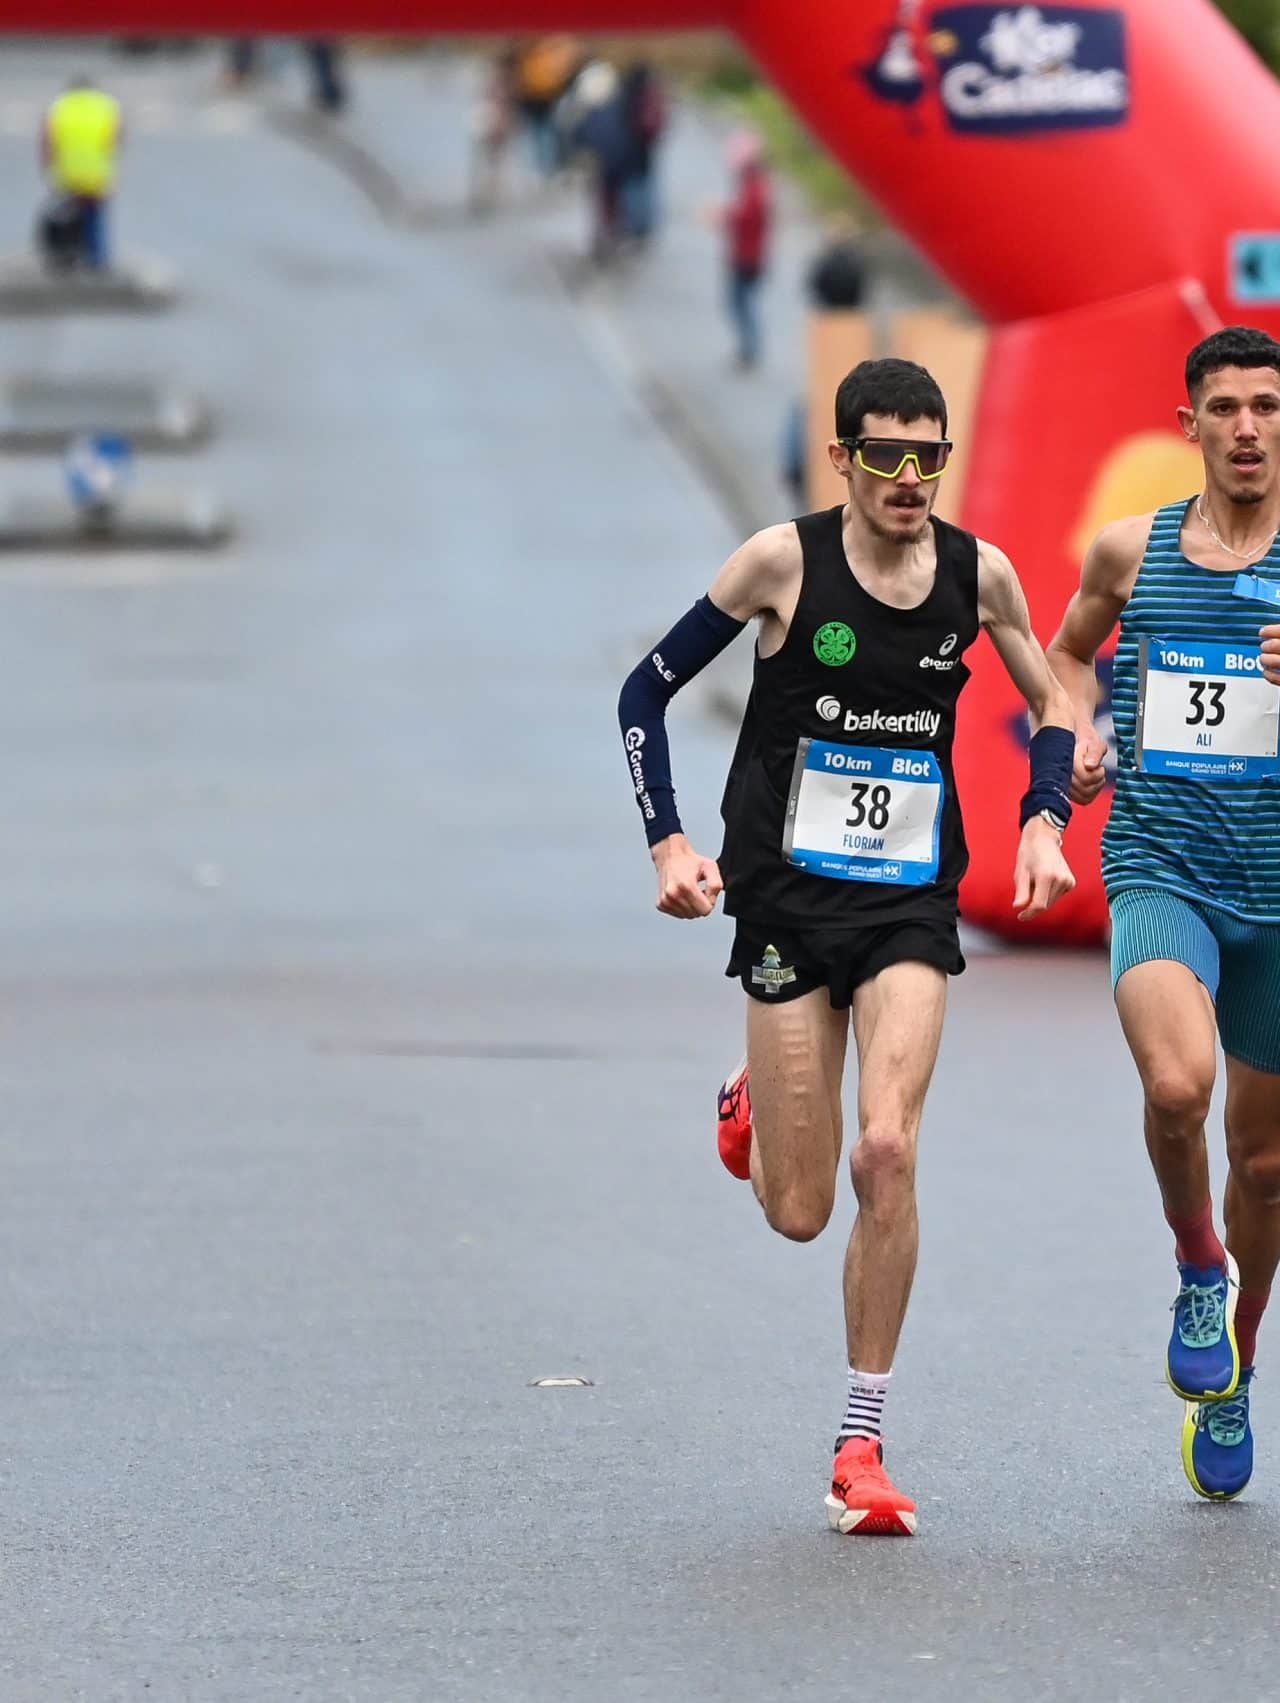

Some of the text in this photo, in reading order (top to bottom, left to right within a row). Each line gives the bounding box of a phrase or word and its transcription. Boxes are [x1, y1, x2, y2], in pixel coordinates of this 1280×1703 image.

[1185, 680, 1227, 727] 33
[843, 709, 941, 737] bakertilly
[1196, 733, 1212, 747] ALI
[891, 757, 931, 777] Blot
[1191, 762, 1227, 770] POPULAIRE
[845, 782, 892, 831] 38
[843, 834, 885, 851] FLORIAN
